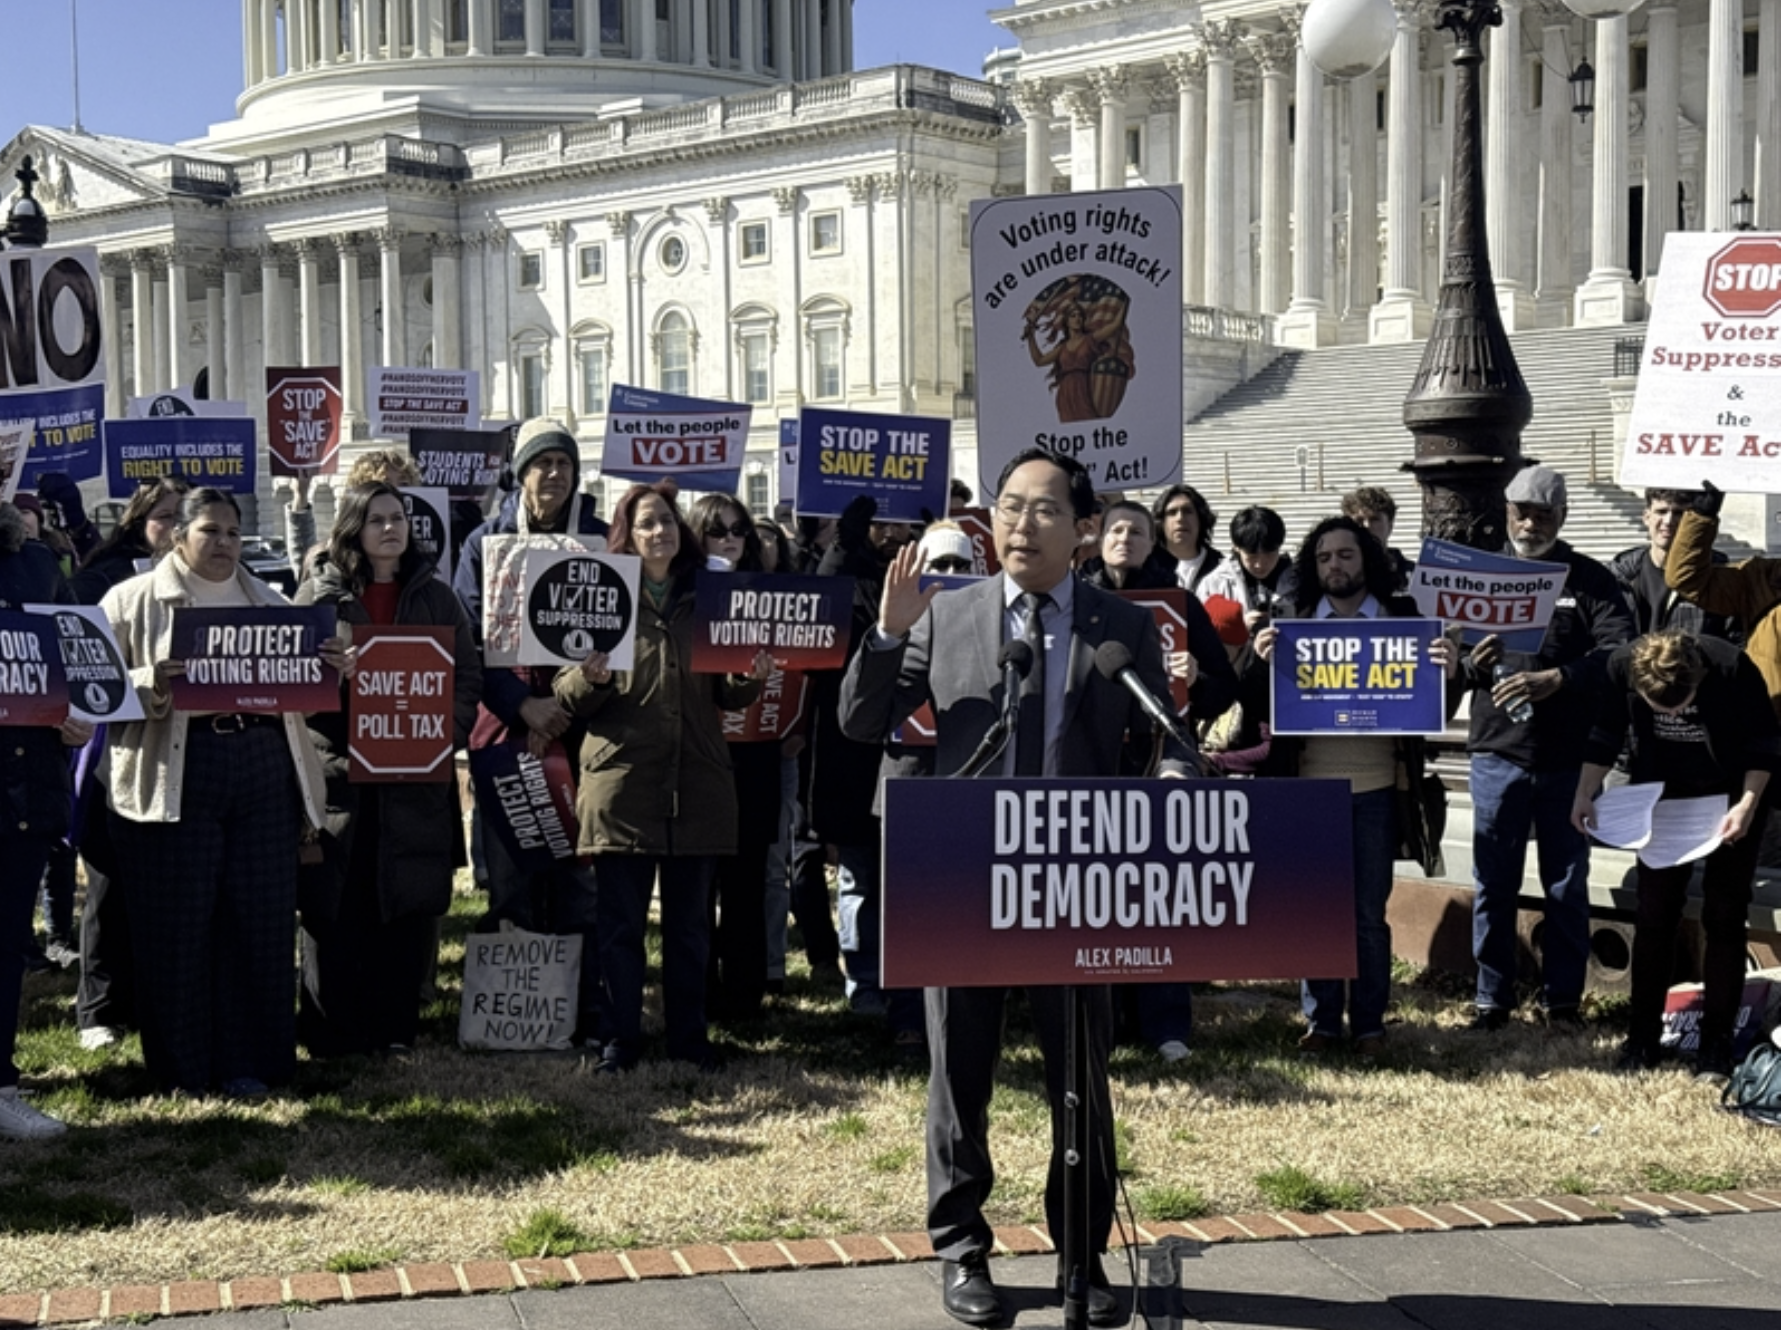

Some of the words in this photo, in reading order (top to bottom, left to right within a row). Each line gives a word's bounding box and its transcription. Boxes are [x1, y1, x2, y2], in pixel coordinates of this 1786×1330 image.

[1000, 210, 1077, 249] Voting
[1086, 204, 1152, 238] rights
[984, 272, 1019, 309] are
[1020, 241, 1089, 278] under
[1095, 241, 1171, 287] attack!
[1701, 322, 1780, 341] Voter
[283, 388, 326, 411] STOP
[383, 398, 404, 408] STOP
[406, 399, 422, 409] THE
[423, 400, 444, 410] SAVE
[445, 401, 462, 411] ACT
[1727, 384, 1745, 400] &
[613, 419, 642, 434] Let
[646, 419, 675, 434] the
[680, 417, 740, 436] people
[1717, 411, 1751, 427] the
[42, 428, 63, 447] TO
[66, 422, 96, 443] VOTE
[820, 425, 879, 451] STOP
[887, 430, 930, 455] THE
[1035, 433, 1085, 457] Stop
[1093, 427, 1128, 448] the
[1637, 433, 1724, 456] SAVE
[121, 444, 172, 459] EQUALITY
[175, 444, 224, 457] INCLUDES
[226, 443, 244, 456] THE
[294, 442, 318, 458] ACT
[418, 451, 486, 469] STUDENTS
[635, 439, 721, 464] VOTE
[122, 459, 173, 478] RIGHT
[180, 459, 201, 476] TO
[205, 458, 244, 475] VOTE
[820, 450, 876, 477] SAVE
[881, 455, 928, 481] ACT
[1104, 457, 1148, 482] Act!
[568, 561, 600, 583] END
[1421, 572, 1451, 590] Let
[1455, 577, 1485, 594] the
[1490, 578, 1553, 595] people
[729, 591, 821, 622] PROTECT
[1441, 594, 1532, 624] VOTE
[56, 616, 85, 637] END
[536, 610, 623, 630] SUPPRESSION
[0, 629, 42, 662] OUR
[206, 625, 304, 656] PROTECT
[709, 621, 771, 646] VOTING
[774, 623, 836, 648] RIGHTS
[1296, 637, 1361, 662] STOP
[1370, 637, 1418, 661] THE
[184, 658, 253, 684] VOTING
[257, 657, 323, 684] RIGHTS
[1296, 663, 1359, 688] SAVE
[1366, 663, 1418, 688] ACT
[357, 671, 406, 696] SAVE
[409, 671, 447, 696] ACT
[358, 714, 405, 739] POLL
[409, 714, 445, 739] TAX
[759, 702, 781, 733] ACT
[517, 752, 553, 807] RIGHTS
[492, 774, 546, 850] PROTECT
[994, 789, 1152, 856] DEFEND
[1164, 789, 1250, 855] OUR
[535, 806, 574, 859] VOTING
[991, 862, 1255, 929] DEMOCRACY
[476, 939, 567, 968] REMOVE
[1075, 948, 1111, 968] ALEX
[1115, 945, 1173, 966] PADILLA
[501, 966, 540, 992] THE
[472, 992, 568, 1023] REGIME
[484, 1020, 555, 1045] NOW!
